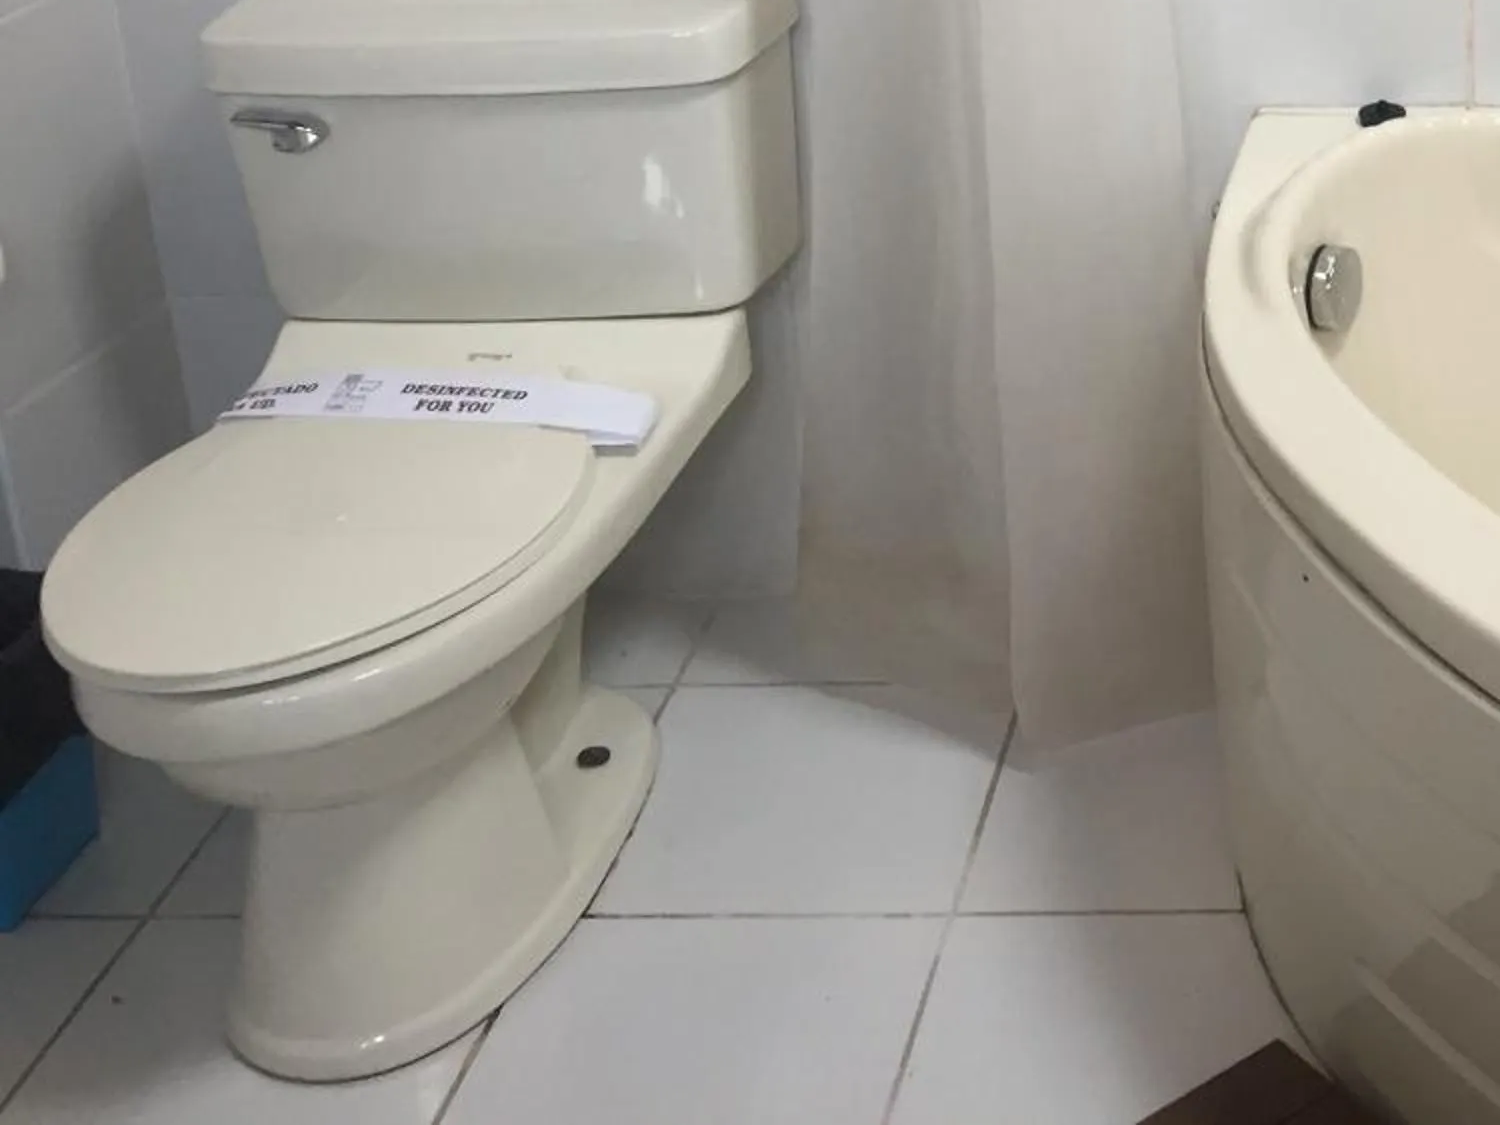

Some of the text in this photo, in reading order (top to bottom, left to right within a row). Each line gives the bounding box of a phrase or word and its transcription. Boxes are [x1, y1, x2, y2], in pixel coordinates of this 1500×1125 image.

[400, 383, 529, 400] DESINFECTED
[414, 399, 495, 414] FOR YOU
